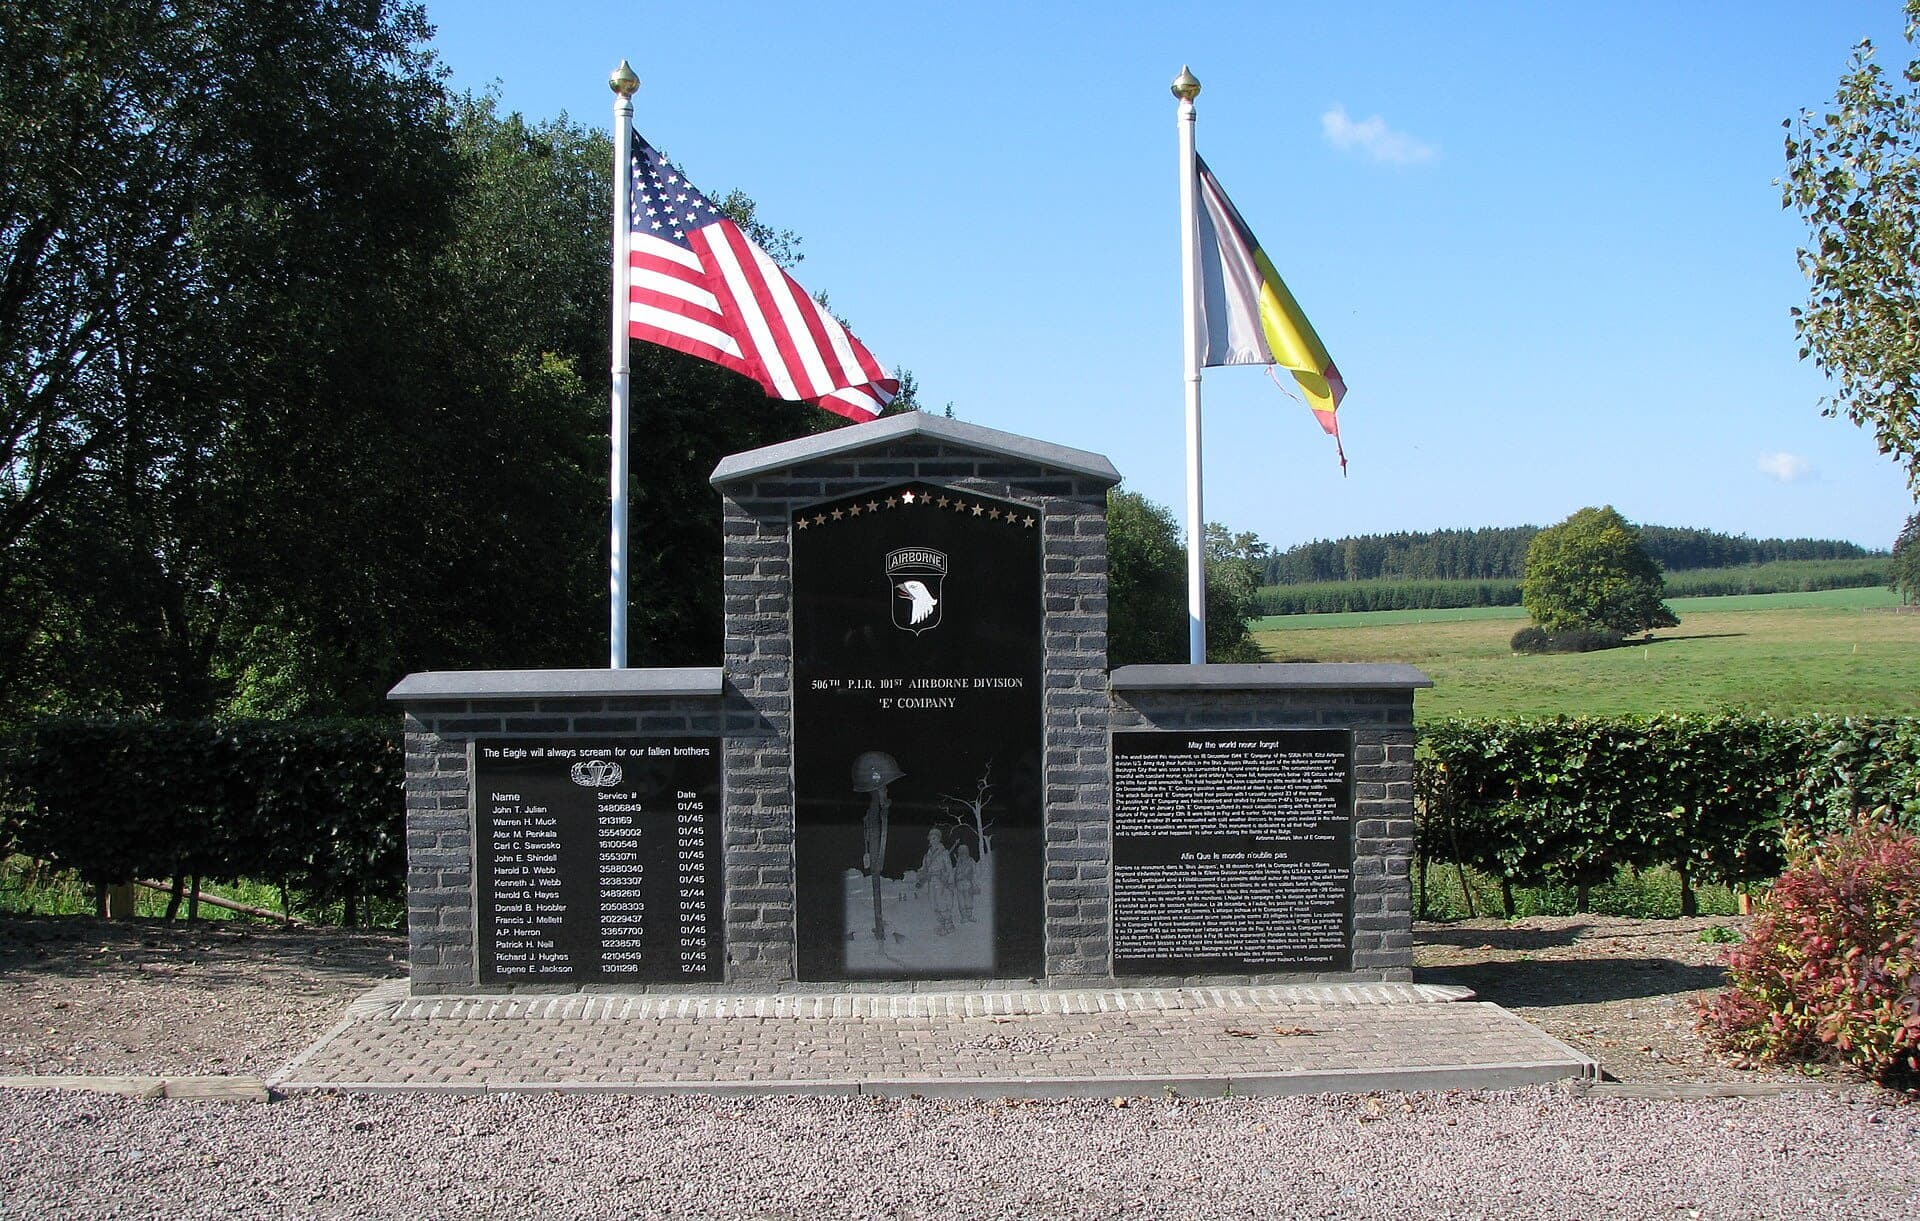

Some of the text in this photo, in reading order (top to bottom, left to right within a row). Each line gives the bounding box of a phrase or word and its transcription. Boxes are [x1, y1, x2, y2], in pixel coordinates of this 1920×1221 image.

[892, 552, 942, 567] AIRBORNE
[848, 680, 875, 688] P.I.R.
[909, 679, 968, 688] AIRBORNE
[974, 678, 1022, 687] DIVISION
[880, 698, 955, 708] 'E' COMPANY
[1260, 741, 1278, 749] forget
[484, 748, 499, 757] The
[504, 748, 526, 759] Eagle
[530, 748, 544, 756] will
[547, 748, 576, 758] always
[615, 747, 626, 756] for
[648, 747, 670, 756] fallen
[674, 747, 709, 755] brothers
[492, 793, 520, 801] Name
[678, 802, 703, 810] 01/45
[678, 814, 703, 823] 01/45
[678, 827, 704, 835] 01/45
[679, 851, 704, 859] 01/45
[679, 863, 704, 871] 01/45
[680, 876, 704, 884] 01/45
[535, 891, 559, 899] Hayes
[680, 889, 704, 897] 12/44
[680, 901, 705, 909] 01/45
[680, 914, 706, 922] 01/45
[681, 926, 706, 934] 01/45
[681, 938, 706, 948] 01/45
[539, 953, 568, 962] Hughes
[681, 952, 706, 960] 01/45
[497, 966, 526, 974] Eugene
[682, 964, 706, 972] 12/44
